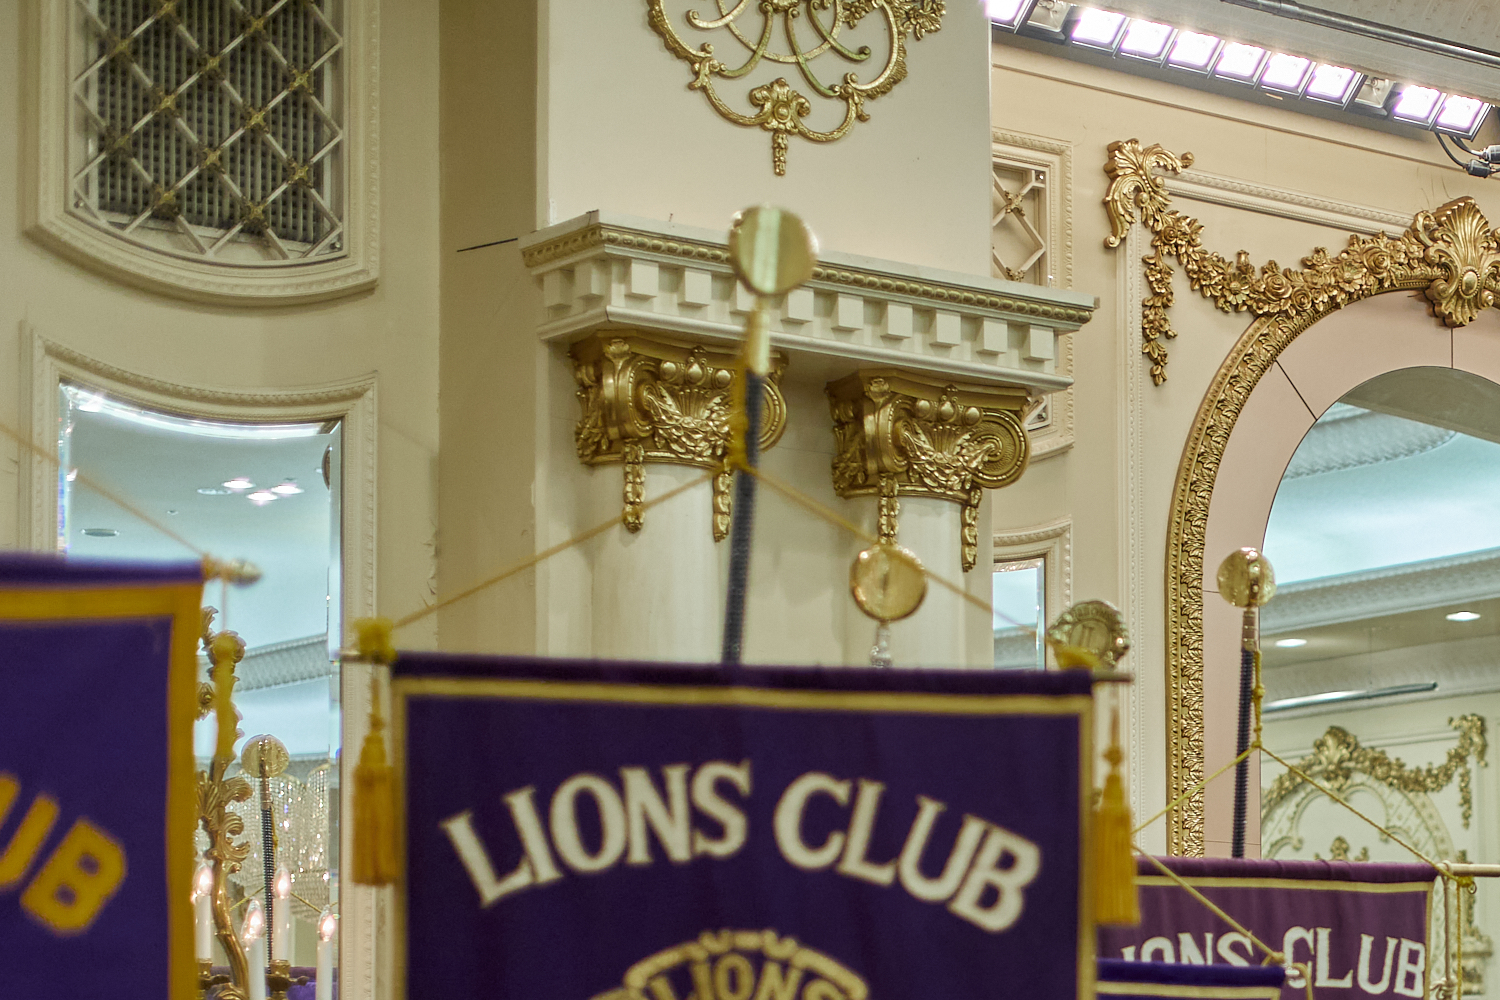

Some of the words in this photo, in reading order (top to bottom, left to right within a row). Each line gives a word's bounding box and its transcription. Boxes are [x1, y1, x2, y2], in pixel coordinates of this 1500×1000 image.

[440, 760, 752, 908] LIONS
[773, 772, 1043, 933] CLUB
[1282, 925, 1426, 999] CLUB
